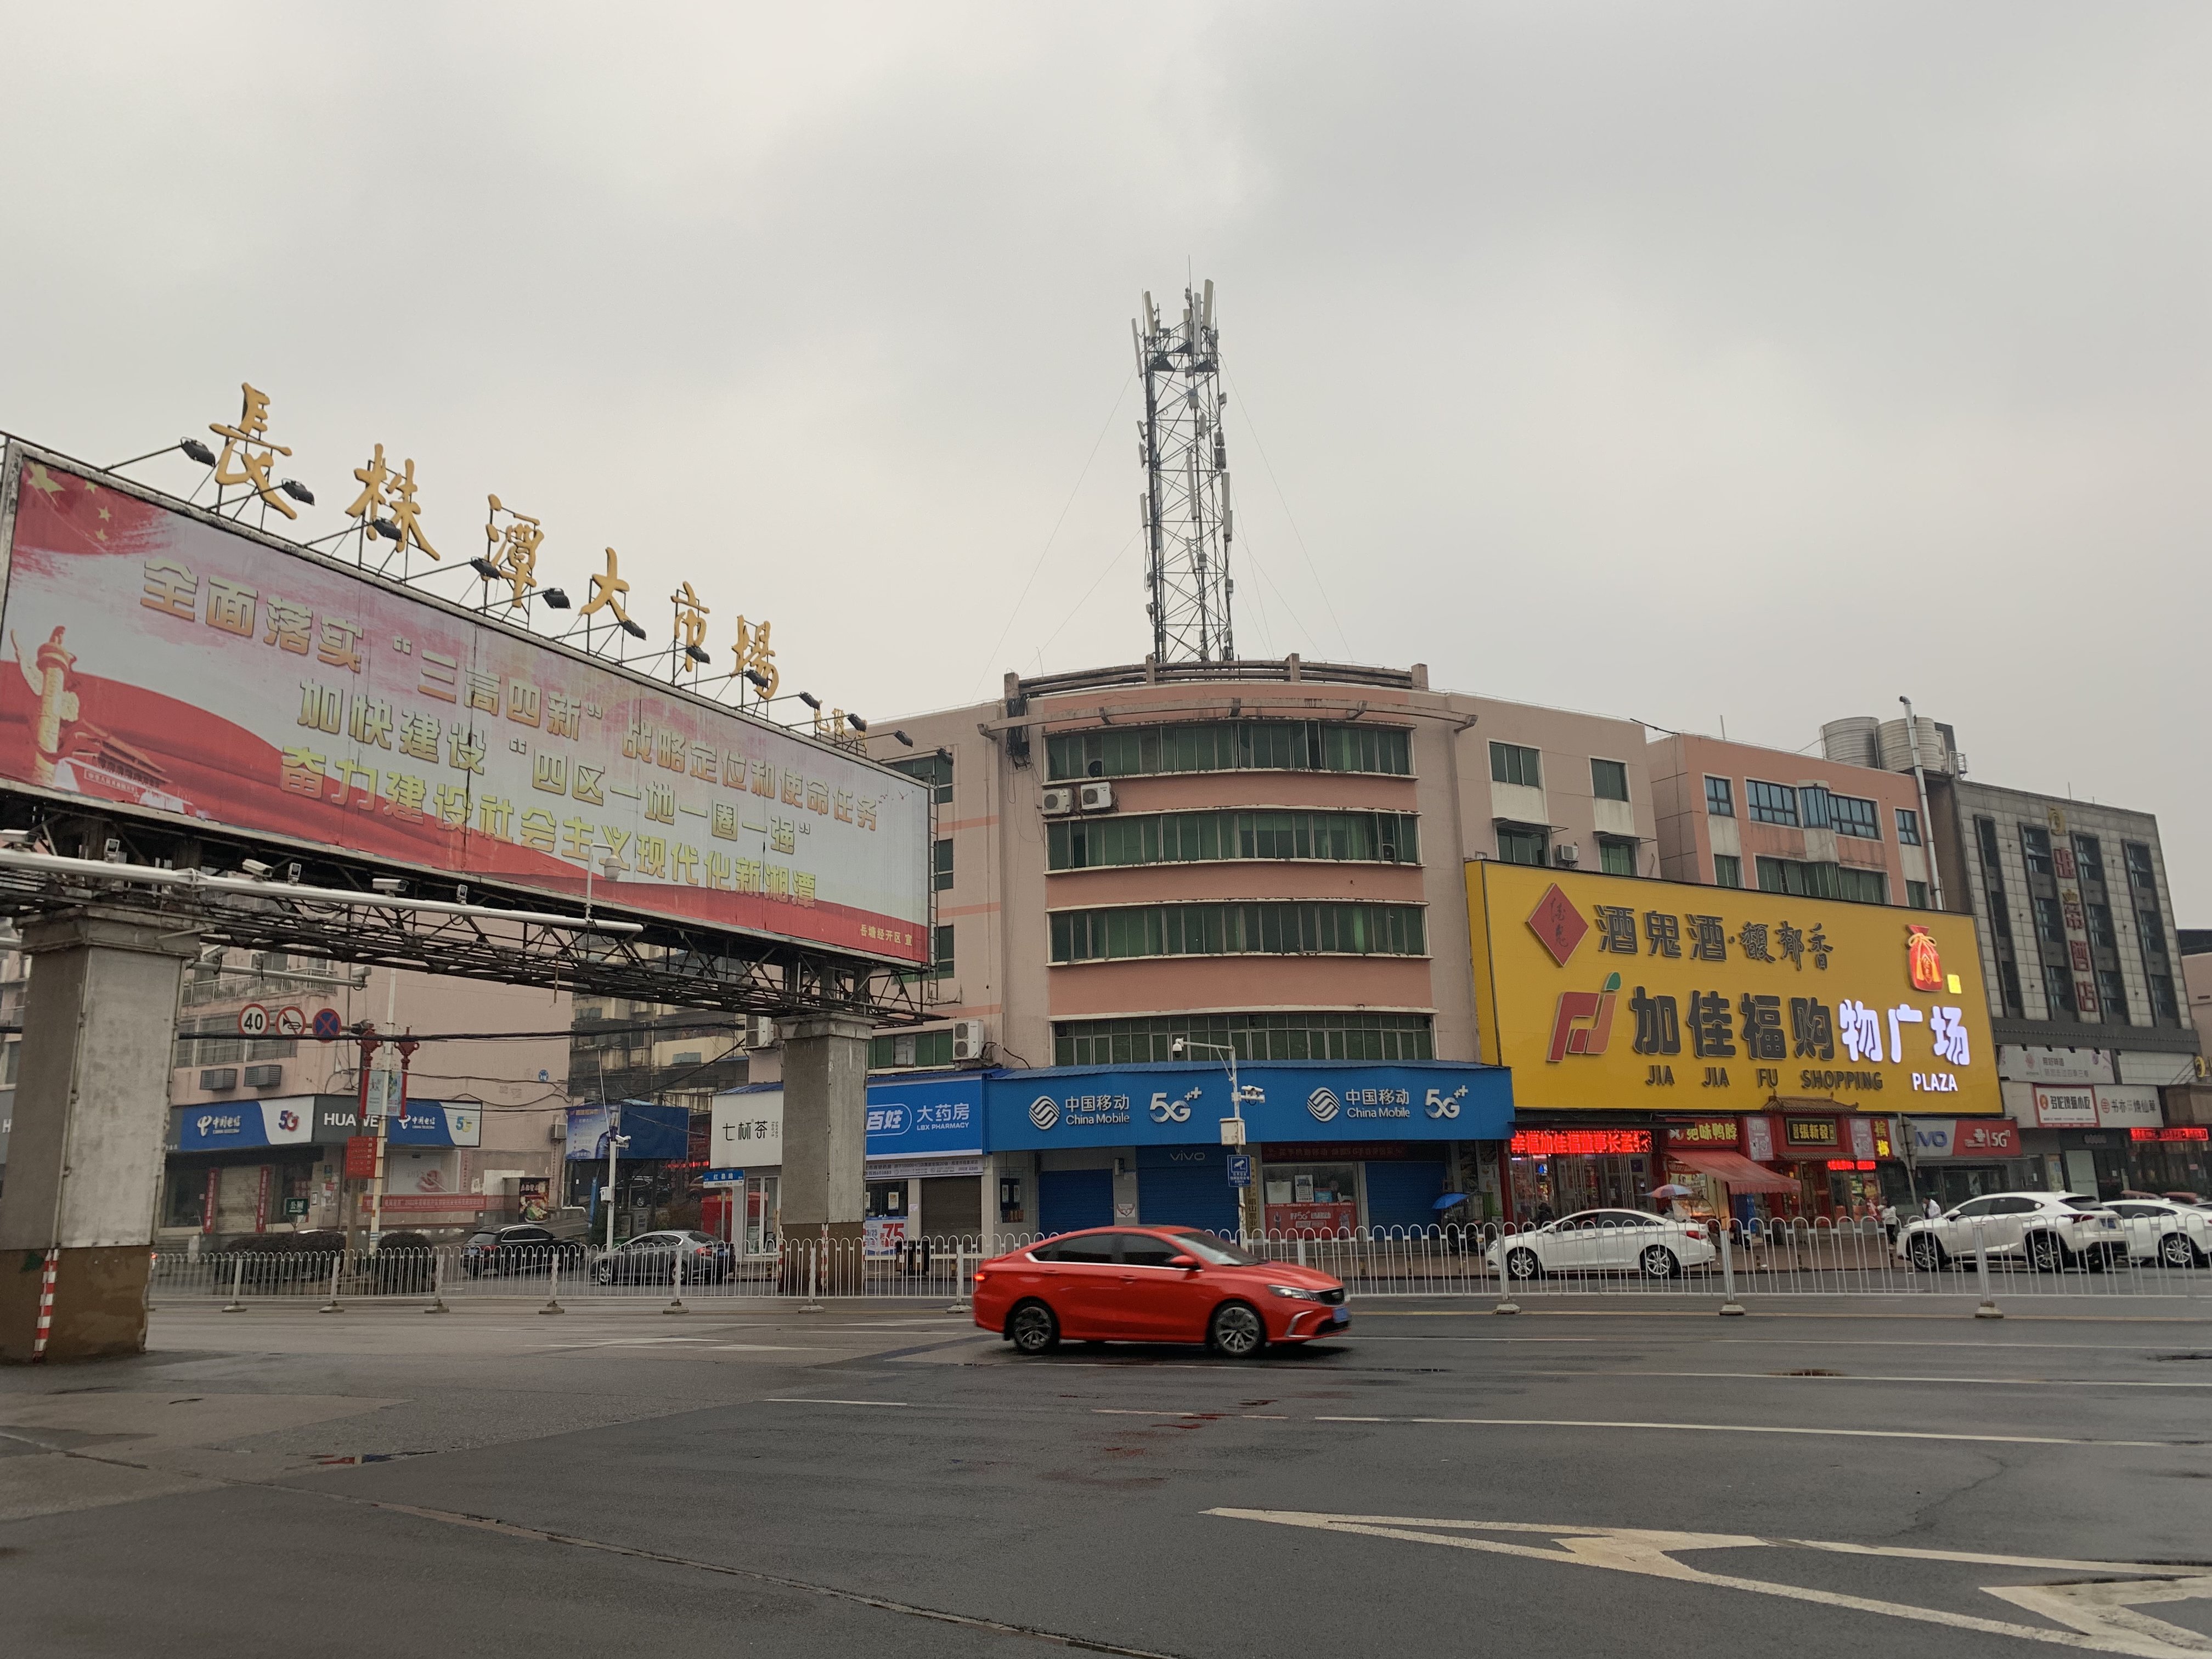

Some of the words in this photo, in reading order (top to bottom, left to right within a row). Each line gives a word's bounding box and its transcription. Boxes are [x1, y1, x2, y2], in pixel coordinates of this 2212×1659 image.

[280, 744, 816, 909] 奋力建设社会主义现代化新湘潭
[860, 924, 901, 944] 岳塘经开区
[244, 1013, 263, 1030] 40
[1629, 985, 1971, 1065] 加佳福购物广场
[1646, 1064, 1675, 1086] JIA
[1702, 1066, 1730, 1087] JIA
[1758, 1068, 1779, 1088] FU
[1801, 1069, 1883, 1090] SHOPPING
[1912, 1072, 1959, 1092] PLAZA
[1065, 1093, 1130, 1113] 中国移动
[1345, 1088, 1409, 1105] 中国移动
[278, 1110, 299, 1132] 5G
[916, 1102, 970, 1123] 大药房
[1065, 1114, 1094, 1125] China
[1096, 1112, 1130, 1124] Mobile
[1347, 1107, 1376, 1118] China
[1378, 1106, 1410, 1118] Mobile
[723, 1120, 768, 1141] 七杯茶
[932, 1122, 970, 1130] PHARMACY
[1686, 1122, 1737, 1141] 绝味鸭脖
[1170, 1150, 1205, 1161] vivo
